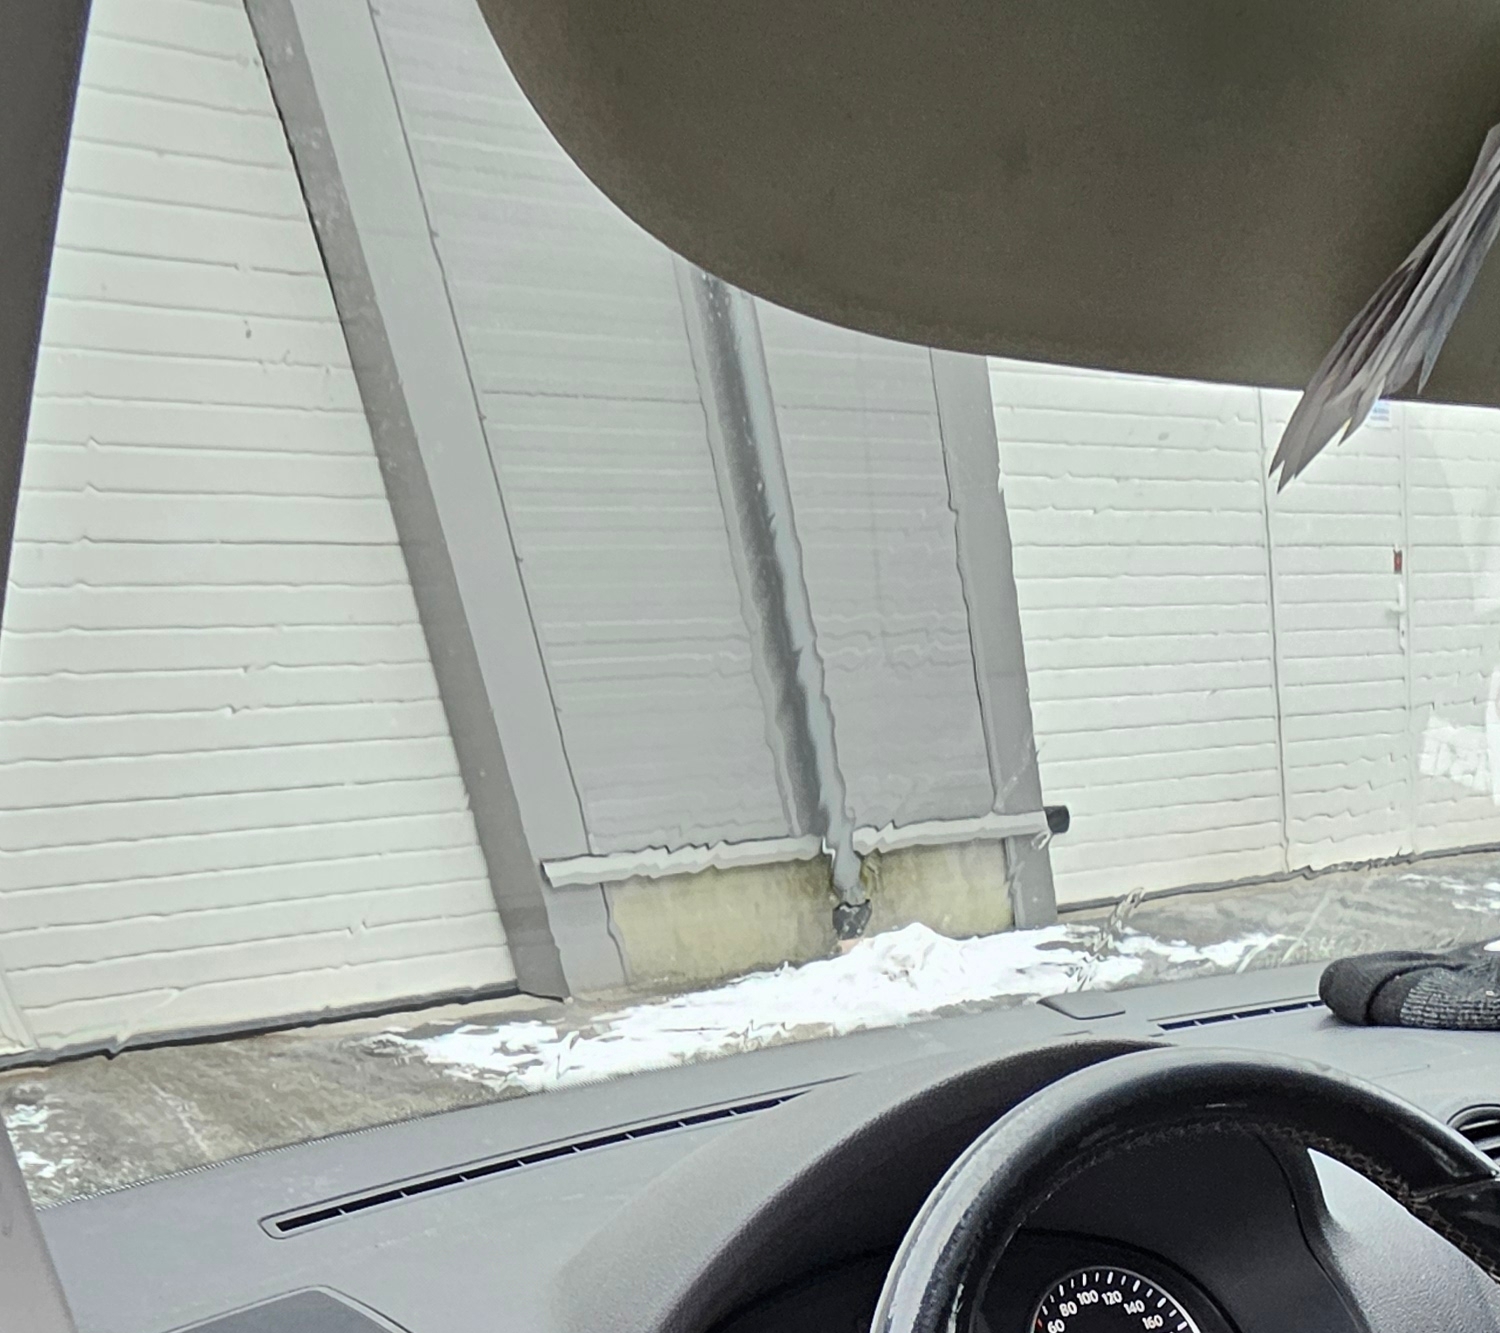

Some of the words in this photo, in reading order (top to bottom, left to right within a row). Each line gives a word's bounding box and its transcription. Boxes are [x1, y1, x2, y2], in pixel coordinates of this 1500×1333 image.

[1076, 1290, 1099, 1305] 100
[1101, 1290, 1123, 1305] 120
[1058, 1301, 1078, 1317] 80
[1123, 1300, 1145, 1315] 140
[1142, 1314, 1163, 1330] 160
